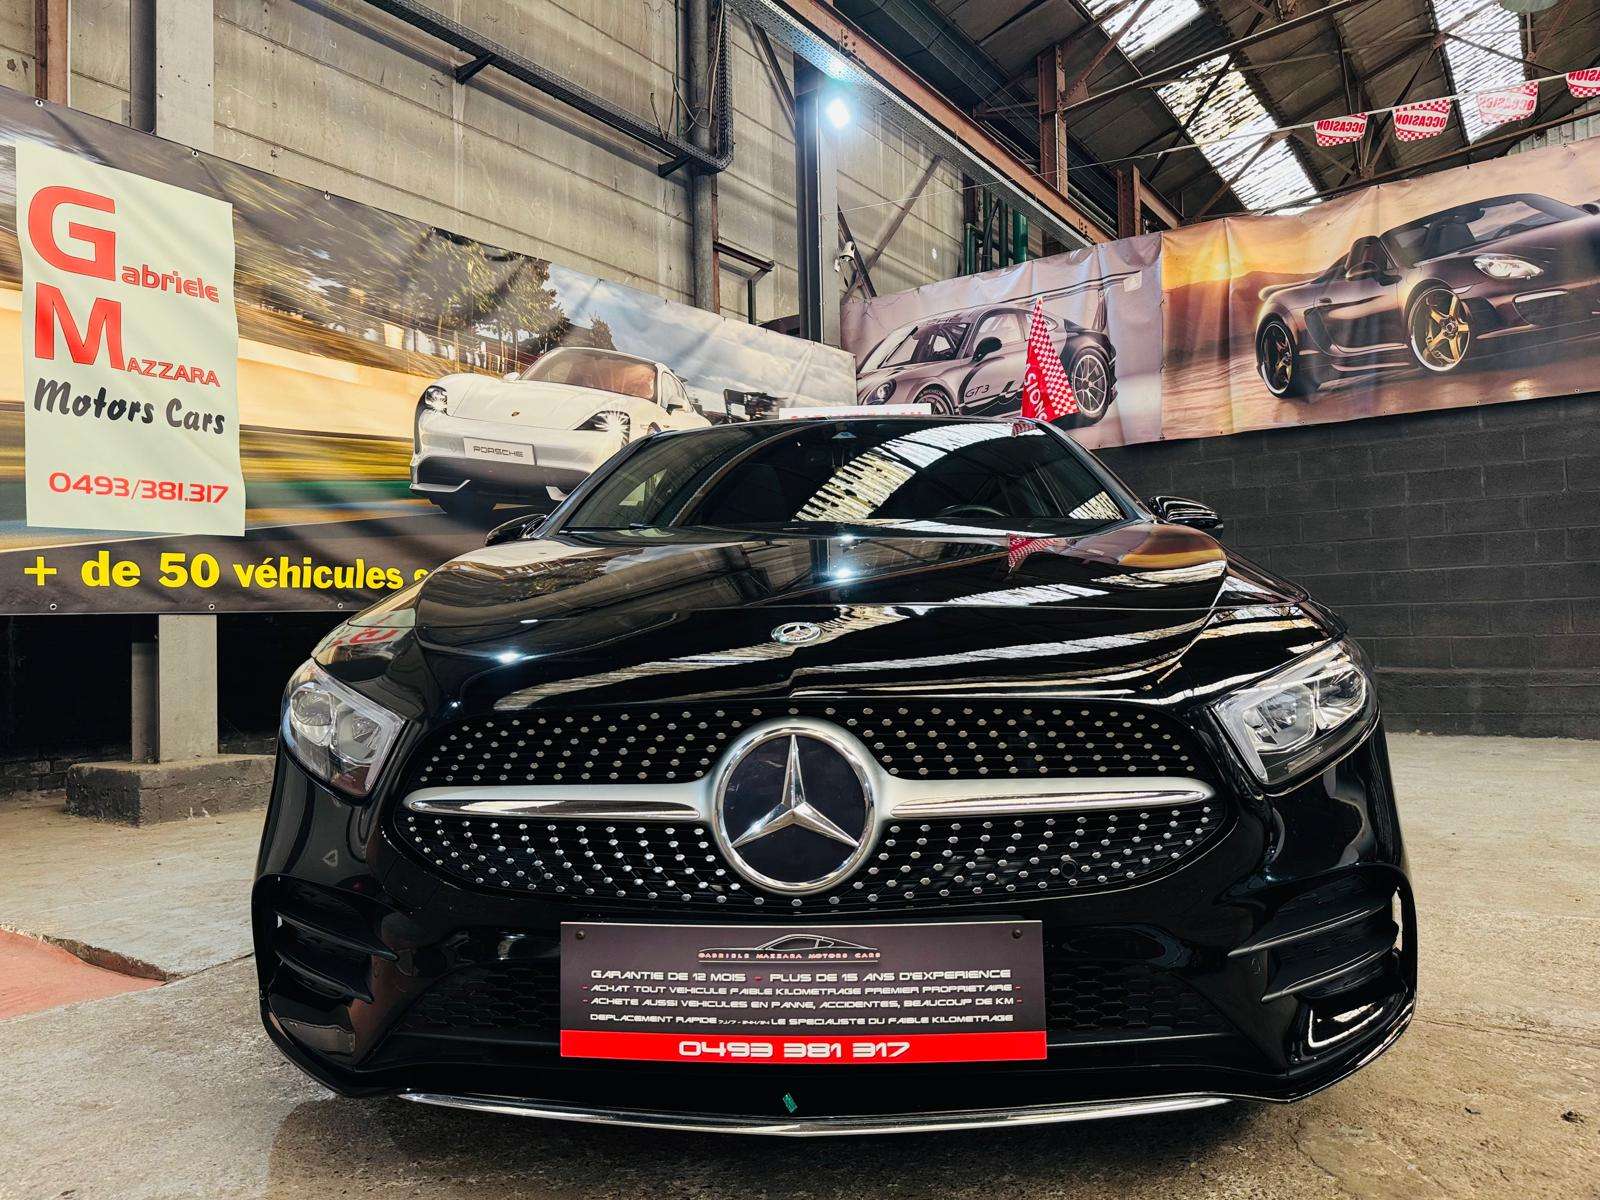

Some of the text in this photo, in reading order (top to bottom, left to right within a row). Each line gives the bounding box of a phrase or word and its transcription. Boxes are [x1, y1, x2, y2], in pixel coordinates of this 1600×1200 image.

[34, 377, 225, 434] Motors Cars
[473, 446, 524, 458] PORSCHE
[49, 472, 229, 503] 0493/381.317
[81, 551, 141, 587] de
[158, 553, 220, 587] 50
[233, 557, 403, 589] véhicules
[591, 969, 1011, 982] GARANTIE DE 12 MOIS PLUS DE 15 ANS D'EXPERIENCE
[590, 985, 630, 993] ACHAT
[633, 985, 666, 993] TOUT
[669, 987, 727, 995] VEHICULE
[776, 987, 862, 996] KILOMETRAGE
[865, 986, 919, 995] PREMIER
[922, 984, 1013, 993] PROPRIETAIRE
[590, 997, 1014, 1010] ACHETE AUSSI VEHICULES EN PANNE, ACCIDENTES, BEAUCOUP DE KM
[590, 1014, 673, 1023] DEPLACEMENT
[676, 1016, 717, 1024] RAPIDE
[868, 1017, 885, 1025] DU
[888, 1016, 929, 1024] FAIBLE
[932, 1015, 1014, 1023] KILOMETRAGE
[679, 1041, 910, 1058] 0493 381 317
